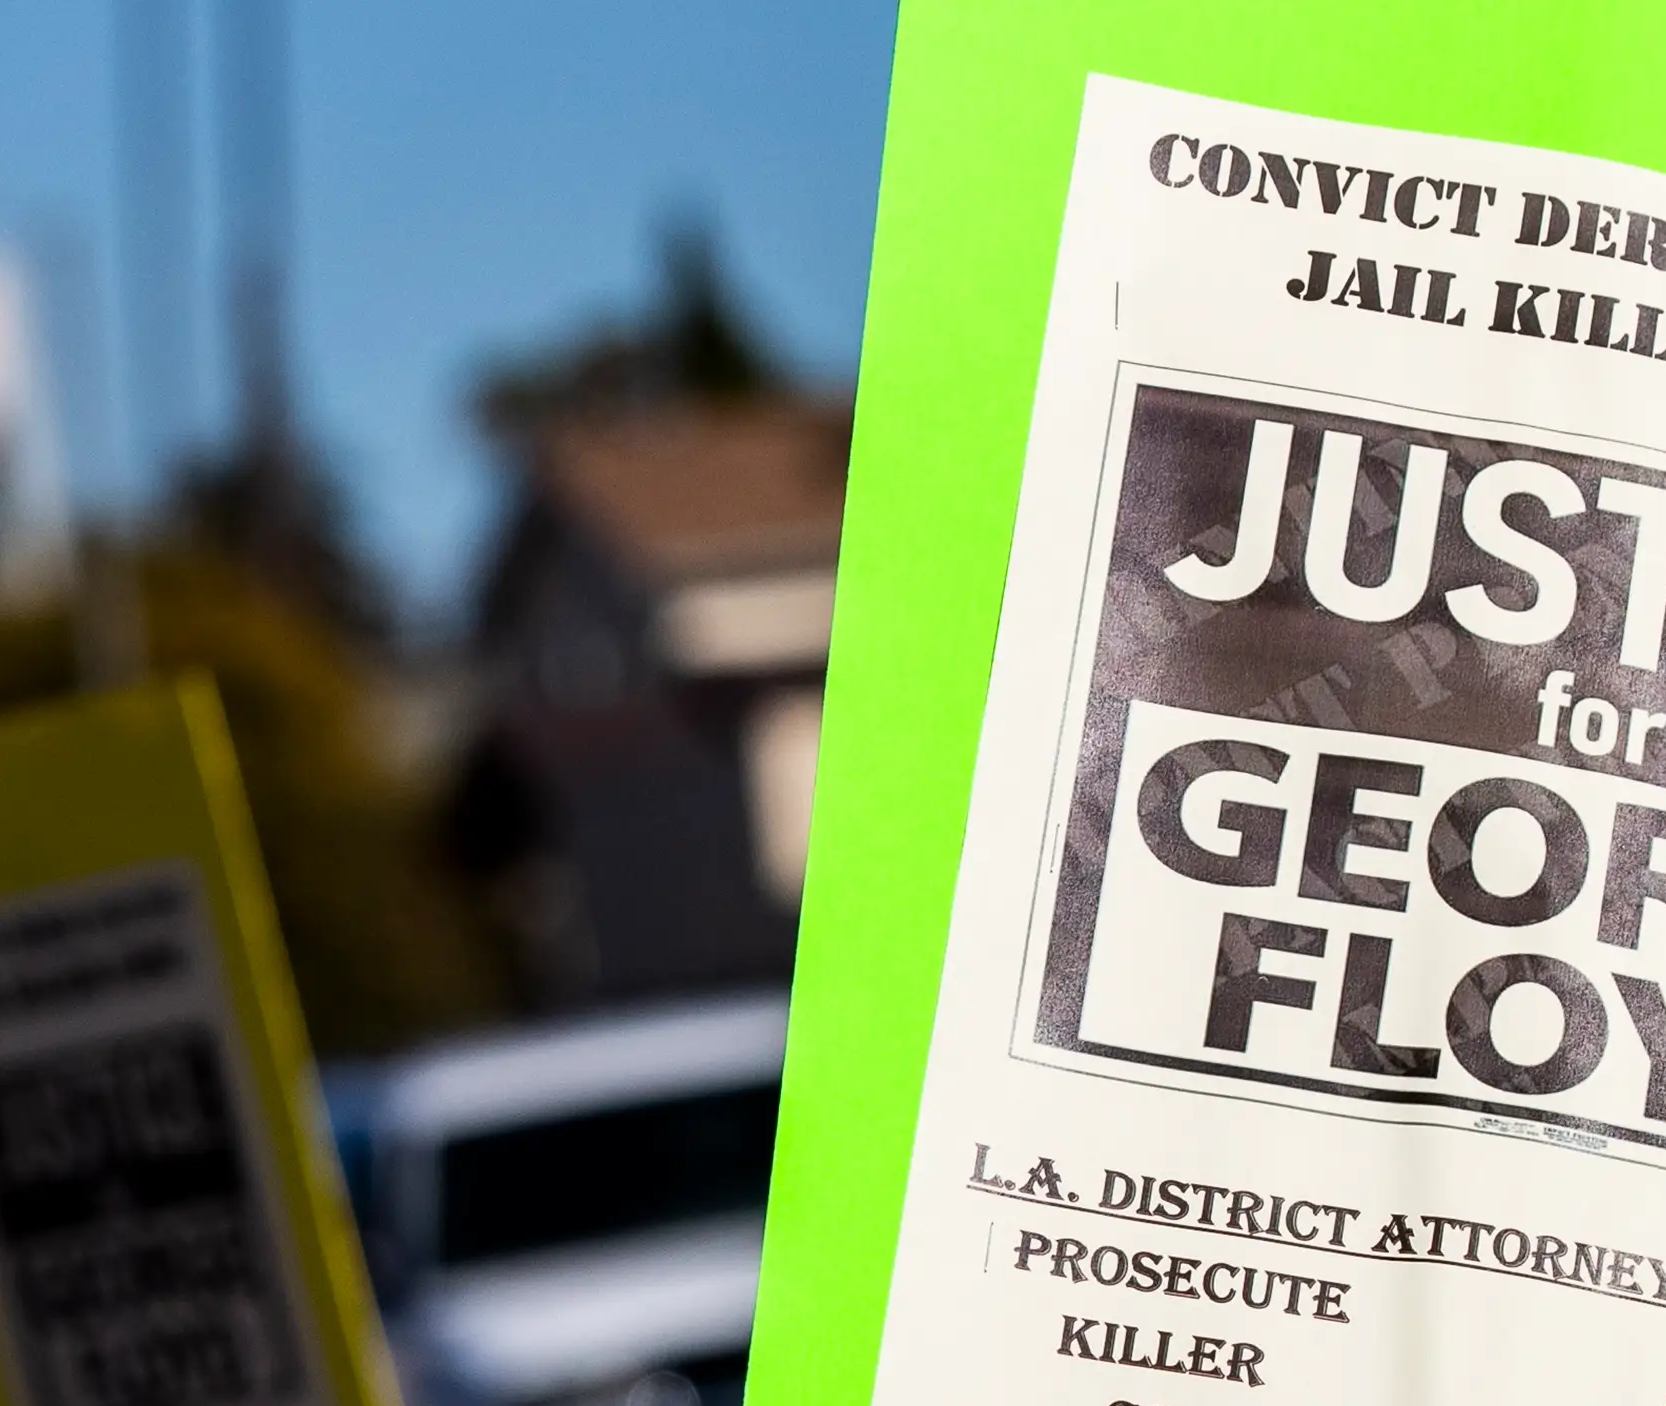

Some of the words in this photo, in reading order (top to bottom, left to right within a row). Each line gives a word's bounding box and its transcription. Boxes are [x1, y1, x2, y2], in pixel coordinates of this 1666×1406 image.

[1149, 133, 1496, 238] CONVICT
[1286, 250, 1467, 328] JAIL
[1536, 670, 1666, 764] for
[970, 1143, 1080, 1204] L.A.
[1099, 1168, 1361, 1248] DISTRICT
[1013, 1228, 1352, 1325] PROSECUTE
[1056, 1314, 1265, 1388] KILLER
